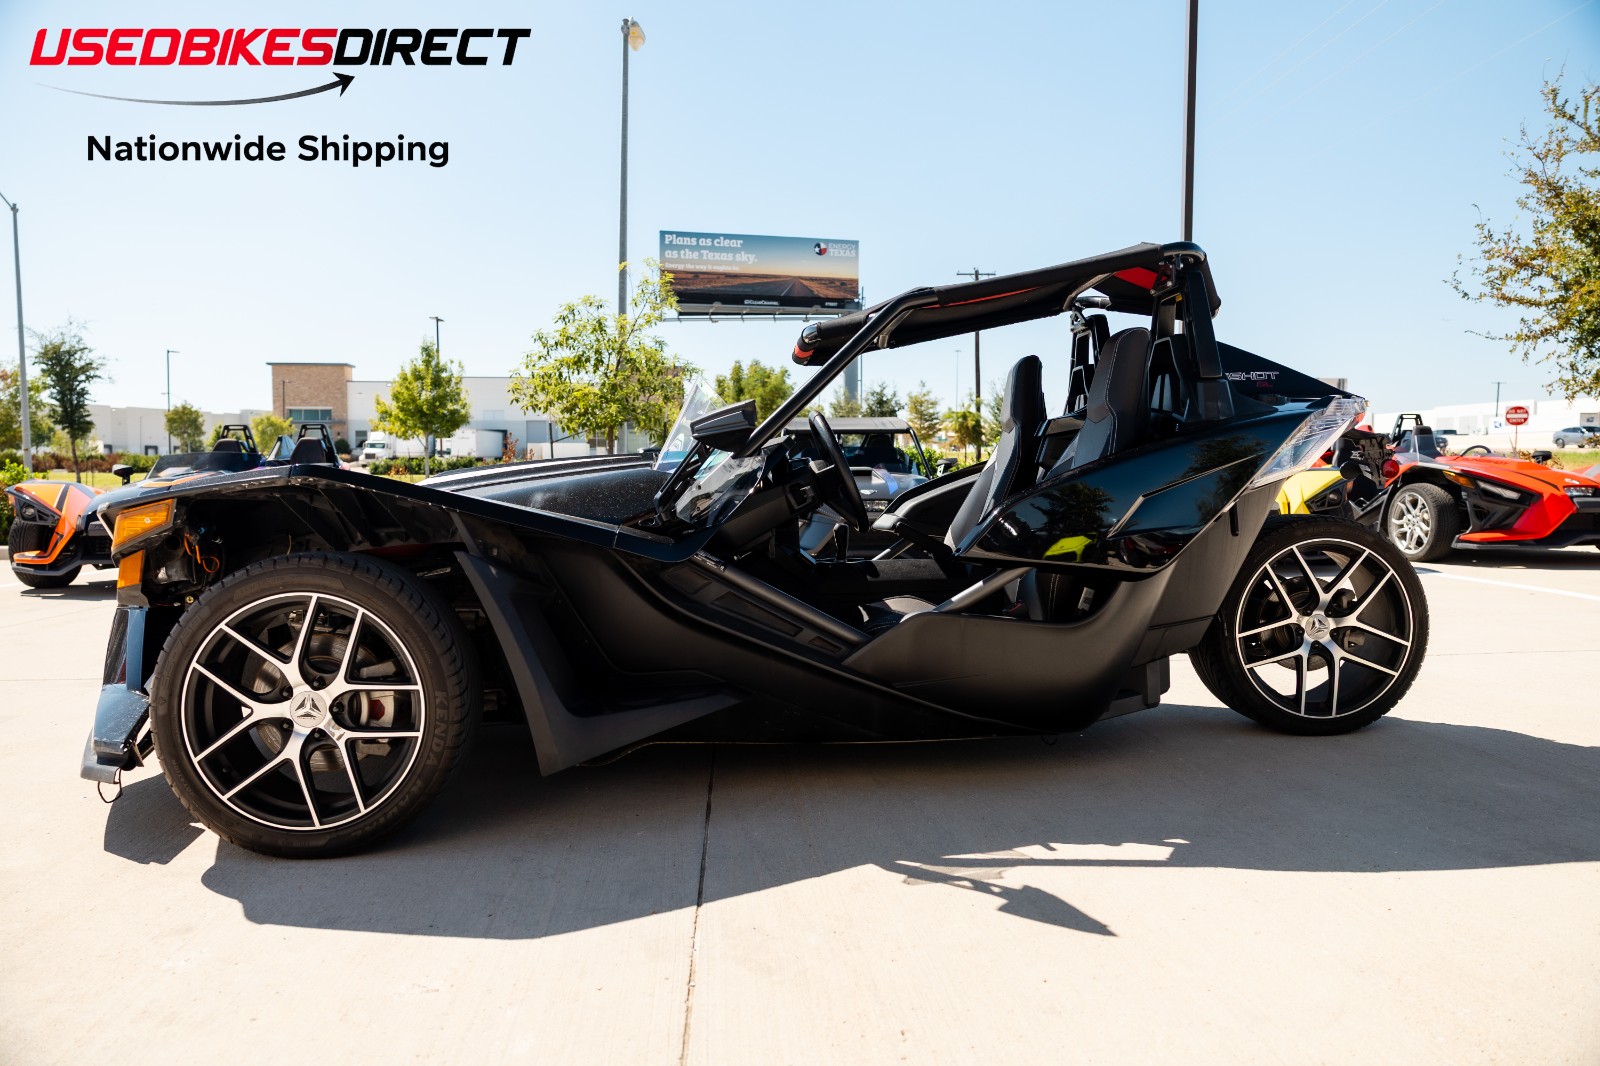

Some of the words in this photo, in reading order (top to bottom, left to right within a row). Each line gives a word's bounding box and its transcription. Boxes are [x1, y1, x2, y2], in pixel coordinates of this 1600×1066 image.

[664, 234, 697, 246] Plans
[699, 238, 712, 246] as
[714, 236, 743, 248] clear
[828, 242, 856, 250] ENERGY
[664, 249, 678, 259] as
[680, 249, 699, 259] the
[701, 250, 734, 261] Texas
[735, 251, 758, 264] sky.
[829, 249, 857, 257] TEXAS
[1225, 371, 1280, 381] SHOT
[424, 690, 449, 767] KENDA
